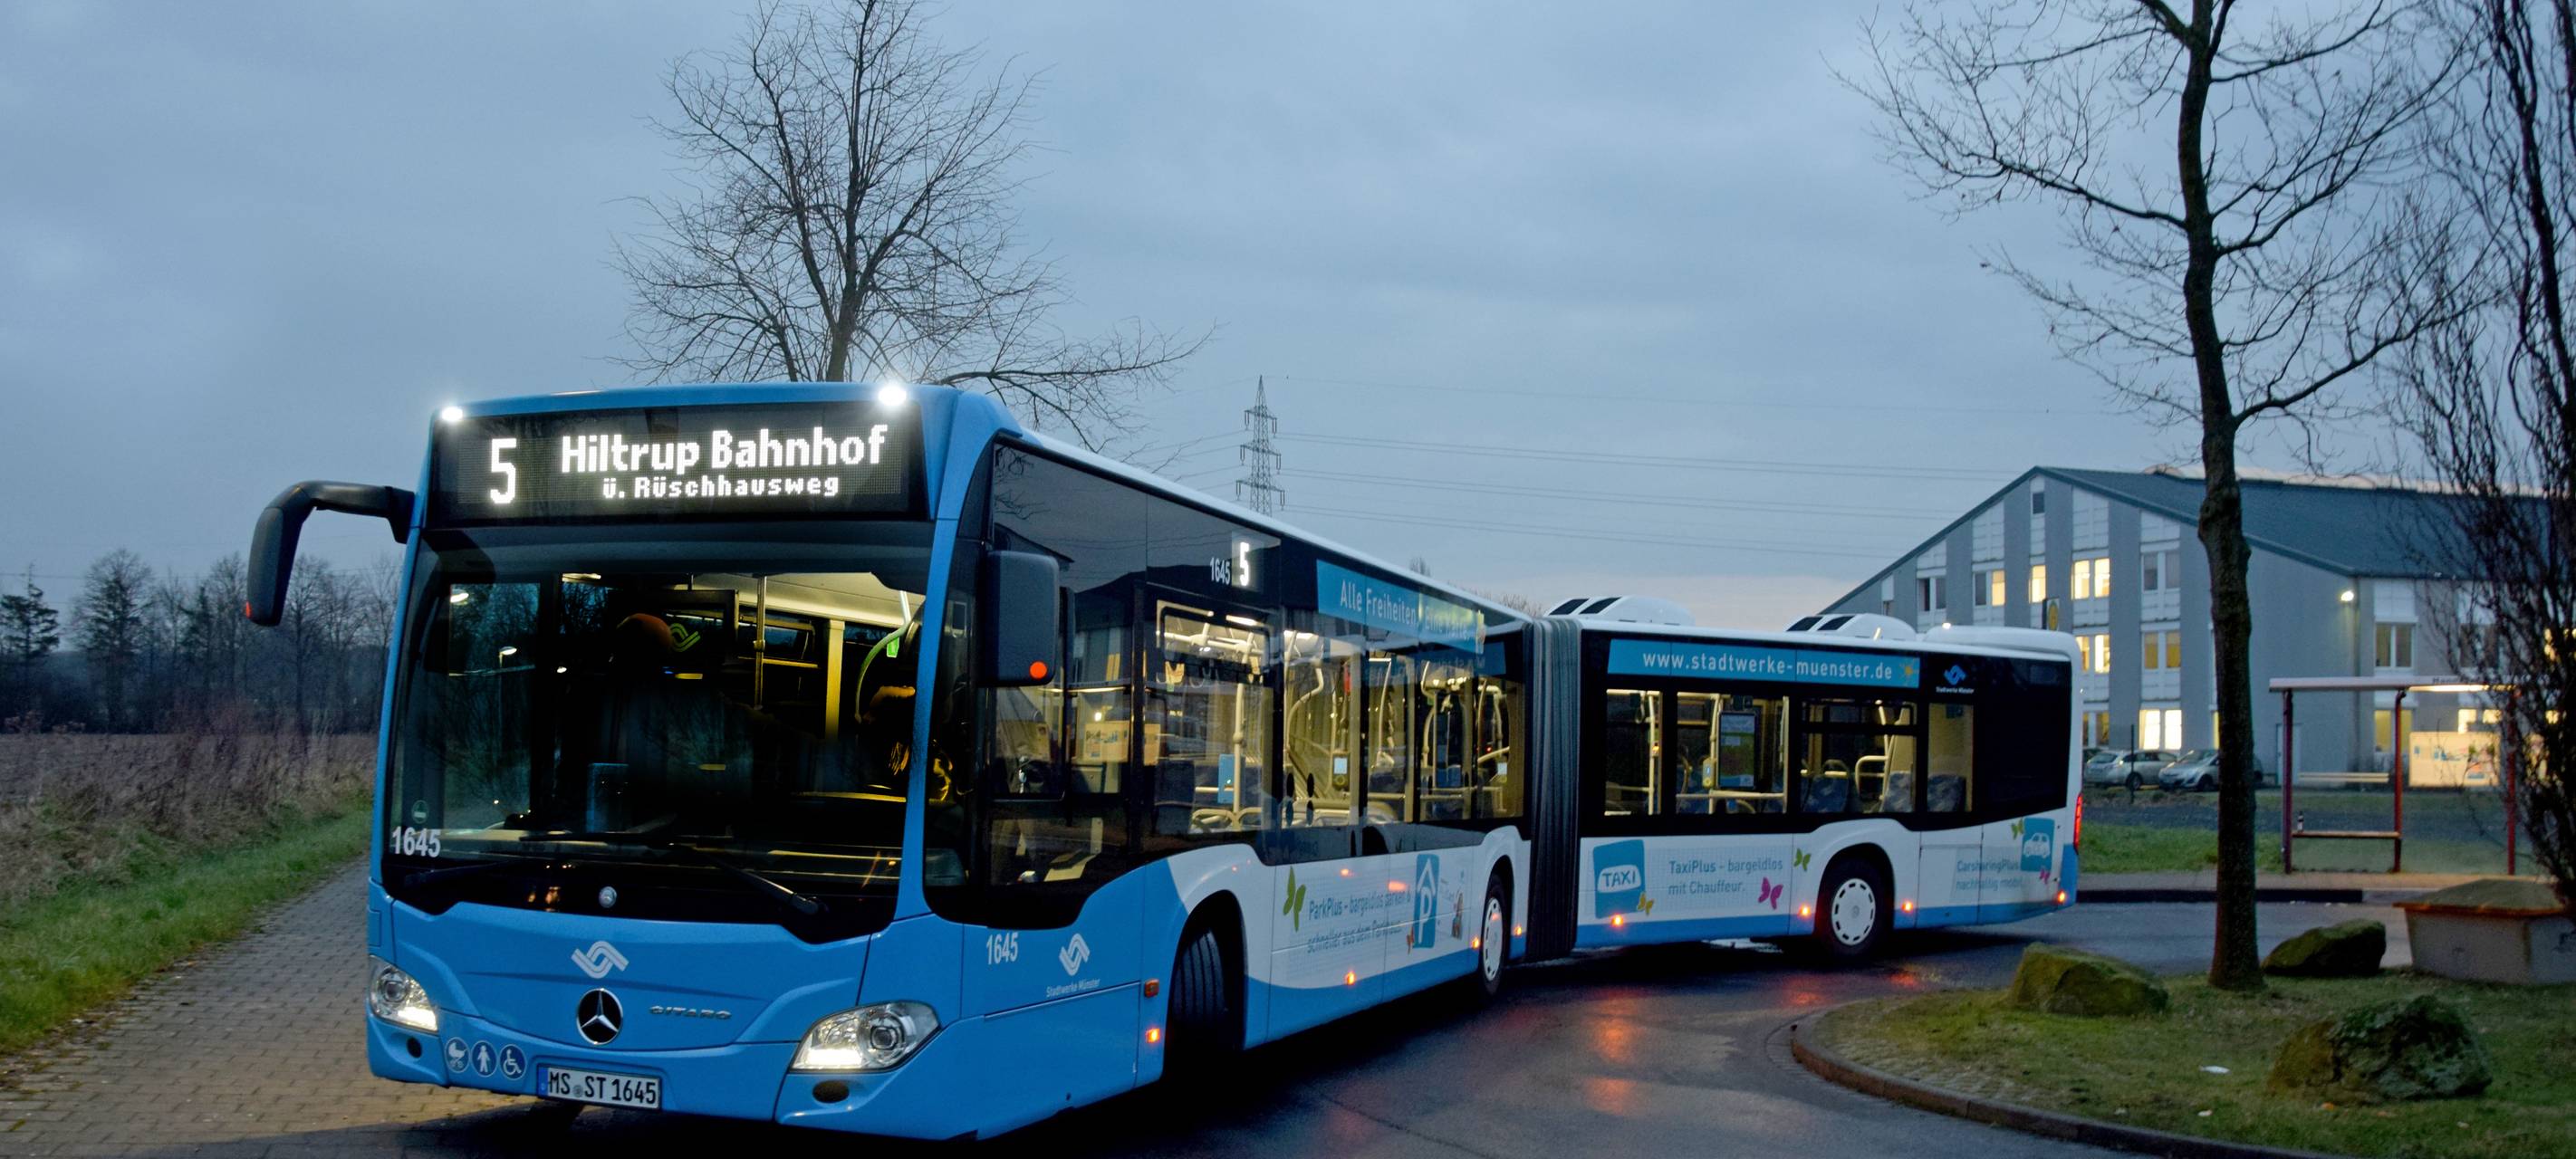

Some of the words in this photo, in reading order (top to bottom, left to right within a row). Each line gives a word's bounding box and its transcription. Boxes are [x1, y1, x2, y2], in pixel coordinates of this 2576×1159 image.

[562, 434, 699, 475] Hiltrup
[711, 424, 888, 470] Bahnhof
[490, 437, 517, 504] 5
[602, 477, 626, 499] ü.
[634, 475, 840, 499] Rüschhausweg
[1209, 557, 1231, 585] 1645
[1238, 541, 1250, 587] 5
[1341, 580, 1363, 613] Alle
[1643, 651, 1892, 680] www.stadtwerke-muenster.de
[392, 826, 441, 857] 1645
[1602, 870, 1637, 887] TAXI
[1669, 859, 1717, 875] TaxiPlus
[1727, 857, 1783, 875] bargeldlos
[1668, 882, 1687, 896] mit
[1689, 879, 1745, 895] Chauffeur.
[1309, 896, 1342, 921] ParkPlus
[986, 932, 1018, 965] 1645
[1046, 982, 1078, 998] Stadtwerke
[649, 1005, 732, 1020] CITARO
[548, 1071, 571, 1095] MS
[584, 1076, 606, 1098] ST
[611, 1078, 657, 1105] 1645
